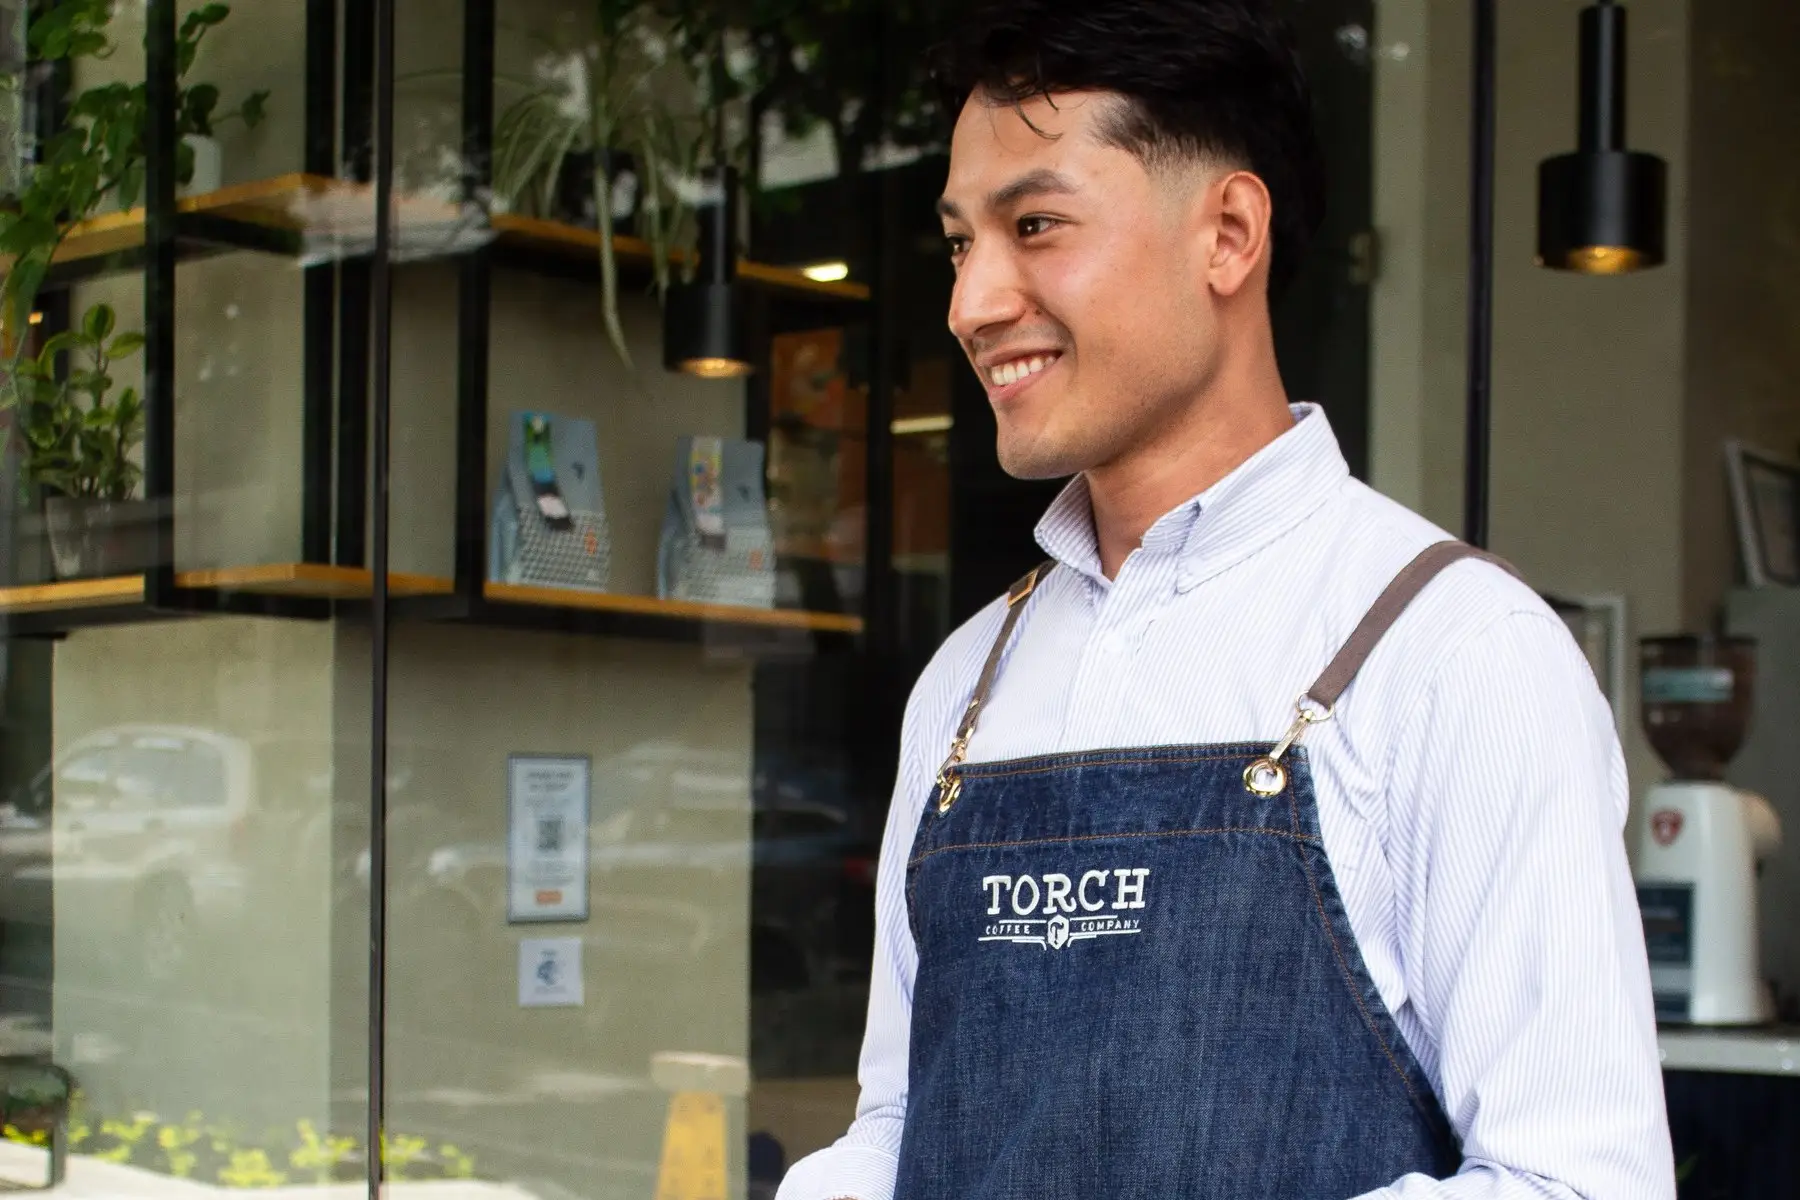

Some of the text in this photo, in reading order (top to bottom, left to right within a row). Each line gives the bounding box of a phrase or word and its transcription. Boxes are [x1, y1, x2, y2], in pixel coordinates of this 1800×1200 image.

[983, 868, 1150, 915] TORCH
[985, 924, 1031, 935] COFFEE
[1081, 919, 1140, 932] COMPANY
